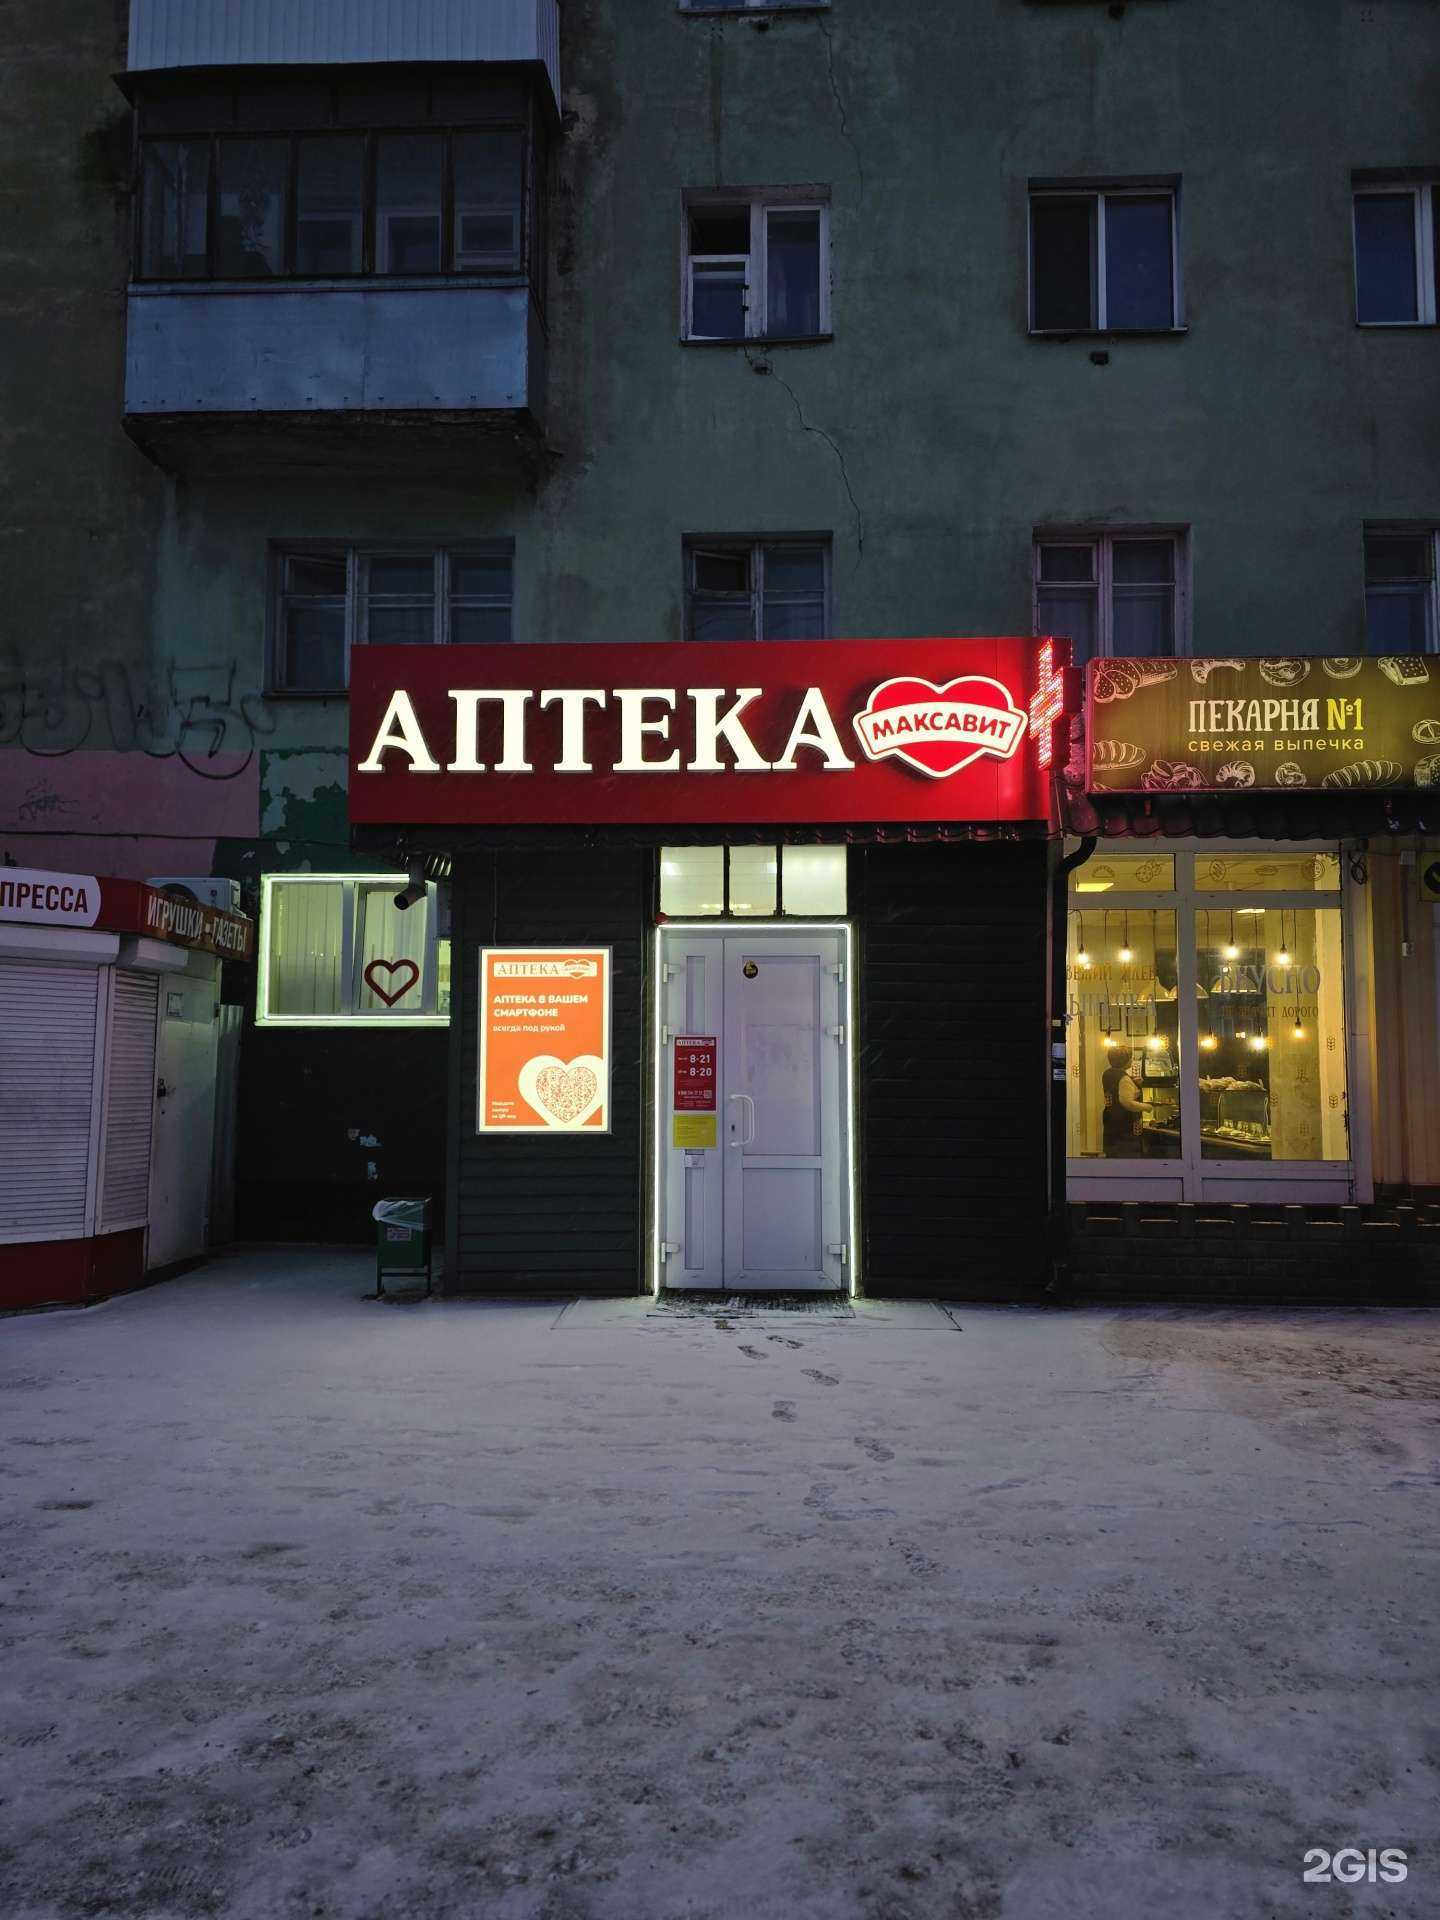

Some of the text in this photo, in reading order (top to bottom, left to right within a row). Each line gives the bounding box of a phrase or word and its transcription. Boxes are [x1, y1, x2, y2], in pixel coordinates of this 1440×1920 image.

[1188, 698, 1364, 732] ПЕКАРНЯ №1
[358, 687, 855, 772] АПТЕКА
[872, 712, 1011, 740] МАКСАВИТ
[1188, 738, 1364, 752] свежая выпечка
[0, 881, 88, 913] ПРЕССА
[147, 895, 247, 952] ИГРУШКИ ГАЗЕТЫ
[498, 964, 559, 975] АПТЕКА
[493, 994, 536, 1004] АПТЕКА
[548, 994, 588, 1004] ВАШЕМ
[493, 1008, 558, 1017] СМАРТФОНЕ
[690, 1054, 710, 1063] 8-21
[690, 1067, 712, 1076] 8-20
